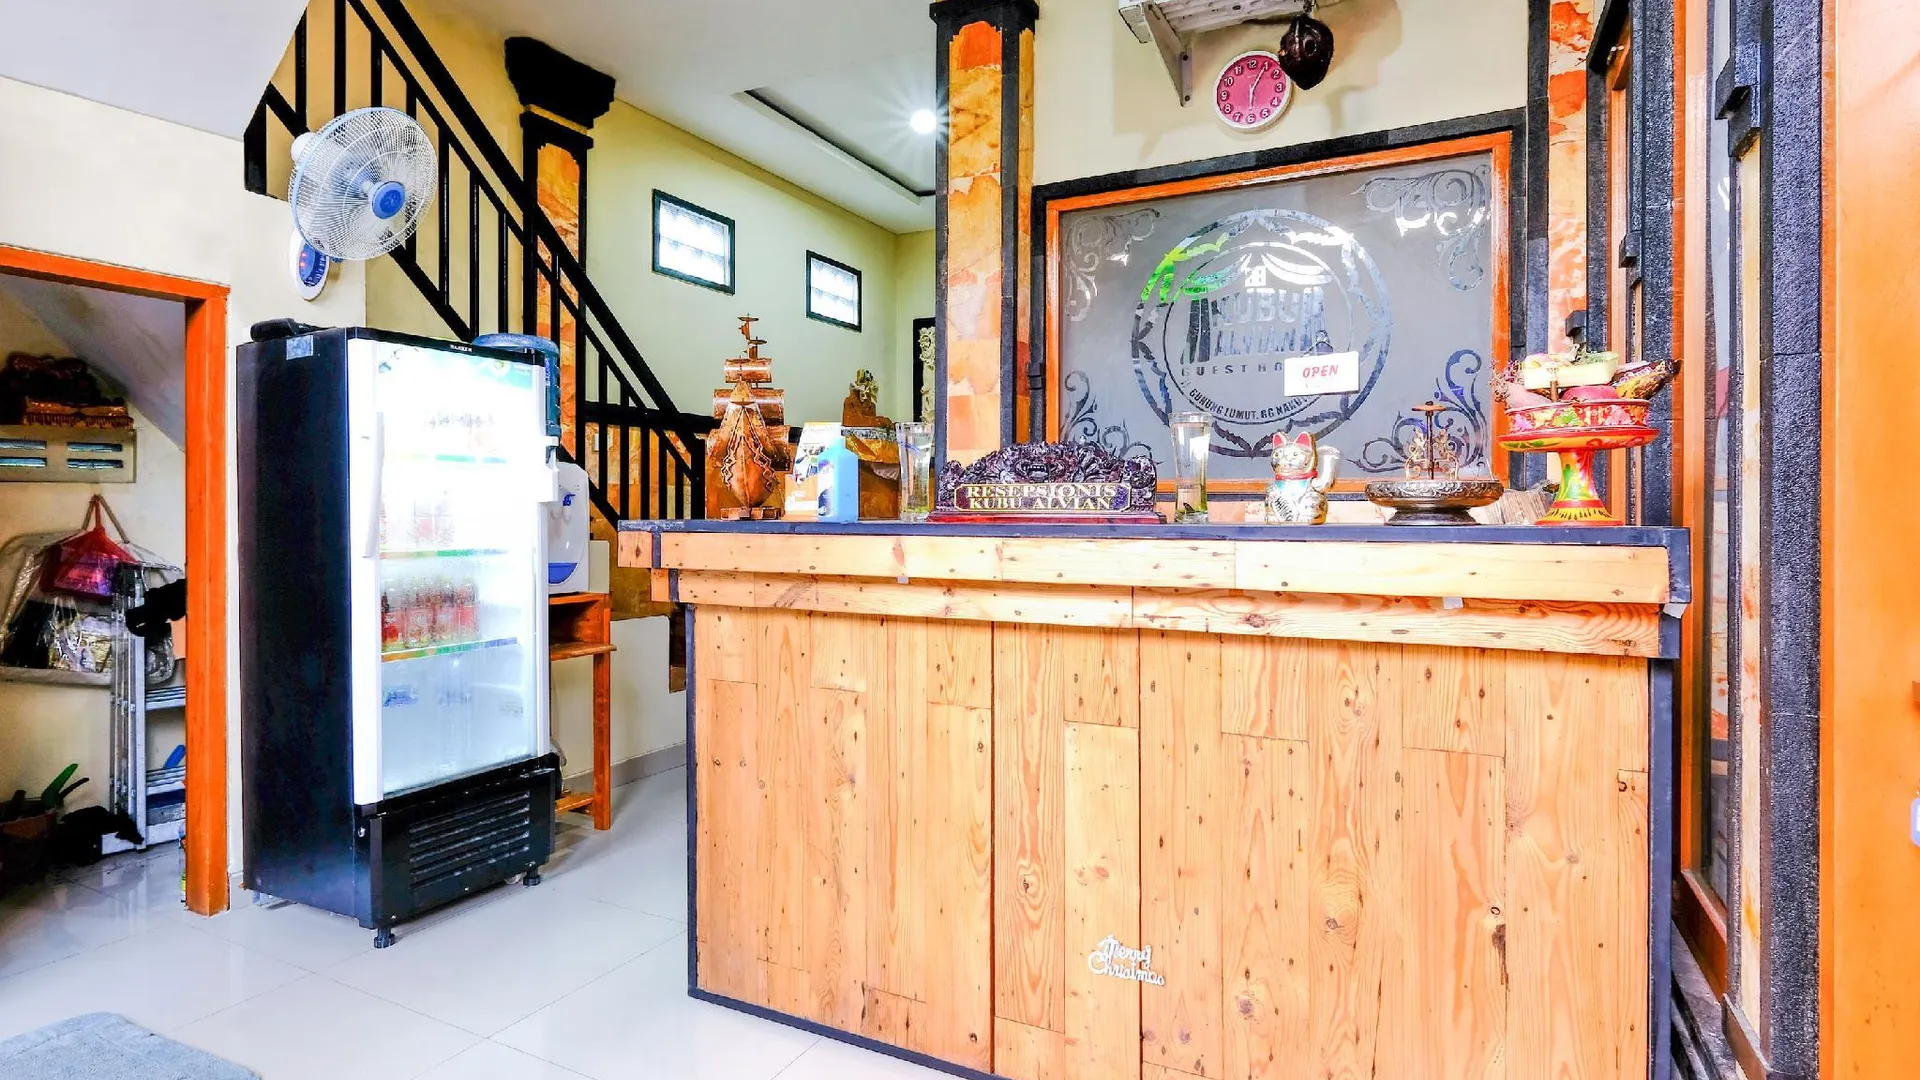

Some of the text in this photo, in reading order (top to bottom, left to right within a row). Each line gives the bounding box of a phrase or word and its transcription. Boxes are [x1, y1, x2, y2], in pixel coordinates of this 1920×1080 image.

[1247, 60, 1257, 68] 12
[1234, 66, 1242, 75] 11
[1273, 69, 1280, 78] 2
[1224, 77, 1234, 86] 10
[1276, 83, 1283, 91] 3
[1221, 91, 1228, 100] 9
[1271, 97, 1279, 106] 4
[1224, 104, 1231, 113] 8
[1234, 113, 1241, 122] 7
[1262, 109, 1269, 118] 5
[1247, 114, 1255, 123] 6
[1181, 364, 1247, 377] GUEST
[1303, 365, 1339, 378] OPEN
[966, 486, 1117, 498] RESEPSIONIS
[969, 497, 1111, 509] KUBU ALVIAN
